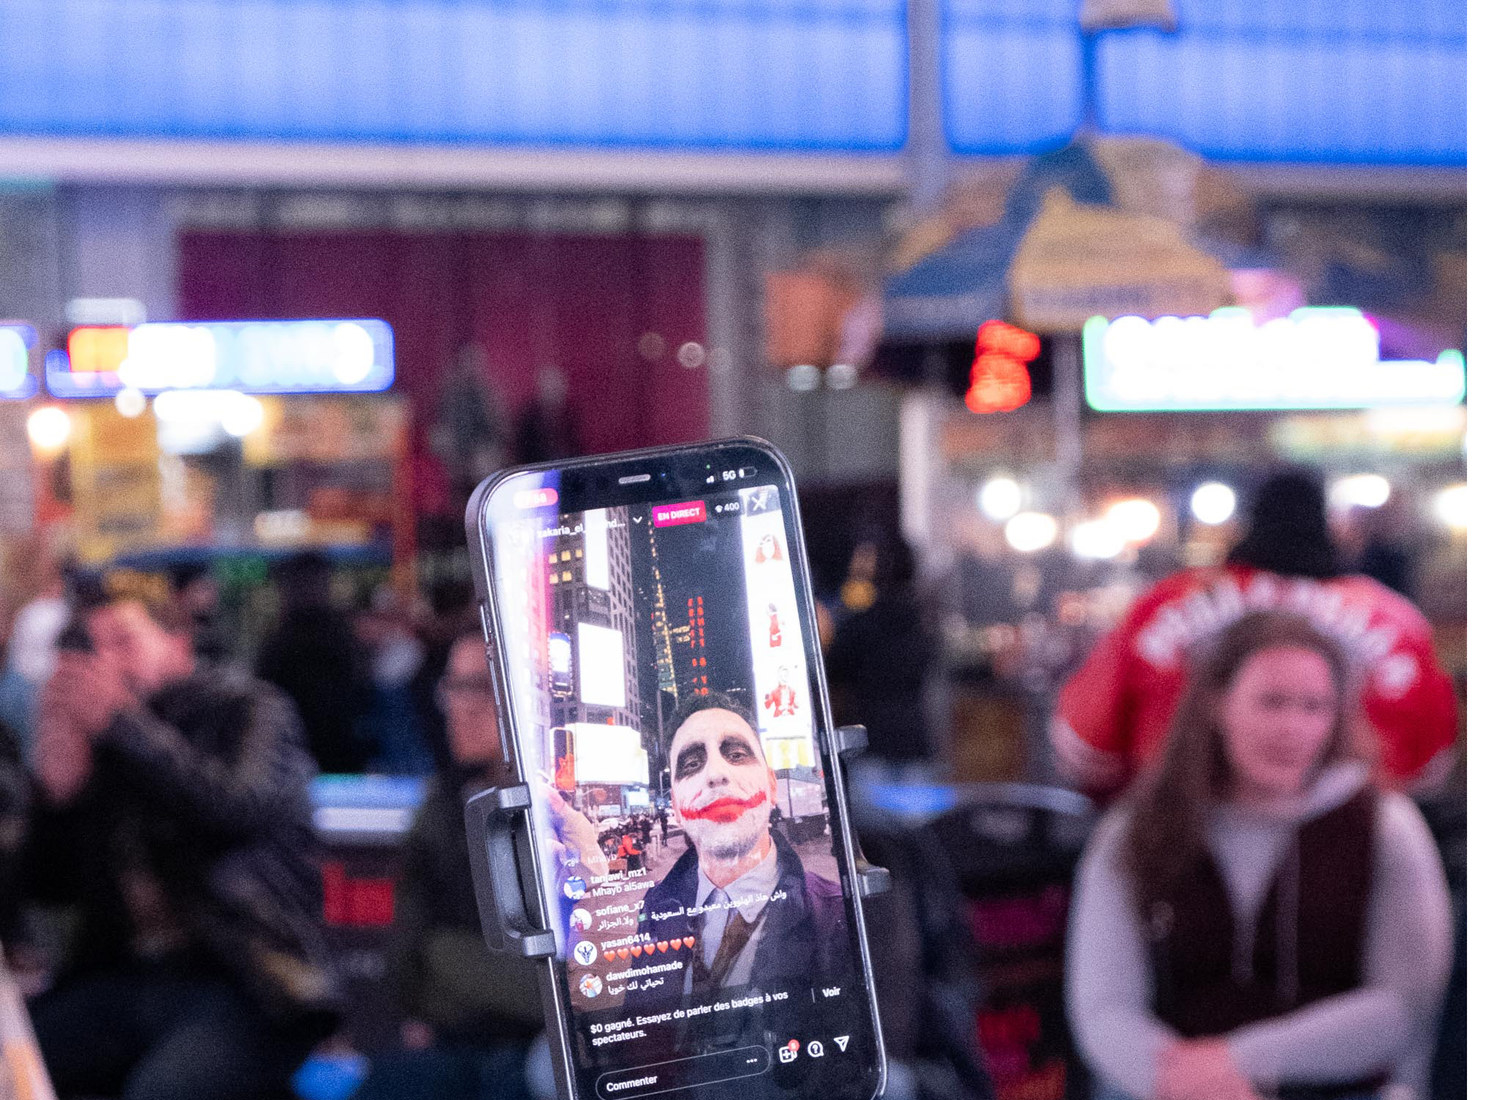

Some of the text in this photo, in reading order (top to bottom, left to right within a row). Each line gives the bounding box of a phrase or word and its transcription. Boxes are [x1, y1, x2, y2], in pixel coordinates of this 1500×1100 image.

[722, 470, 736, 481] 5G
[657, 507, 700, 521] EN DIRECT
[724, 502, 739, 512] 400
[595, 900, 645, 916] sofiane_x7
[651, 906, 685, 921] السعودية
[601, 932, 651, 950] yasan6414
[606, 961, 683, 981] dawdimohamade
[607, 977, 664, 995] تحياتي لك خويا
[822, 987, 841, 998] Voir
[590, 1024, 603, 1034] $0
[604, 1018, 635, 1032] gagné.
[636, 1012, 672, 1025] Essayez
[673, 1009, 685, 1019] de
[686, 1005, 712, 1017] parler
[713, 1002, 730, 1012] des
[731, 996, 763, 1009] badges
[772, 992, 789, 1001] vos
[592, 1030, 647, 1047] spectateurs.
[606, 1076, 658, 1092] Commenter
